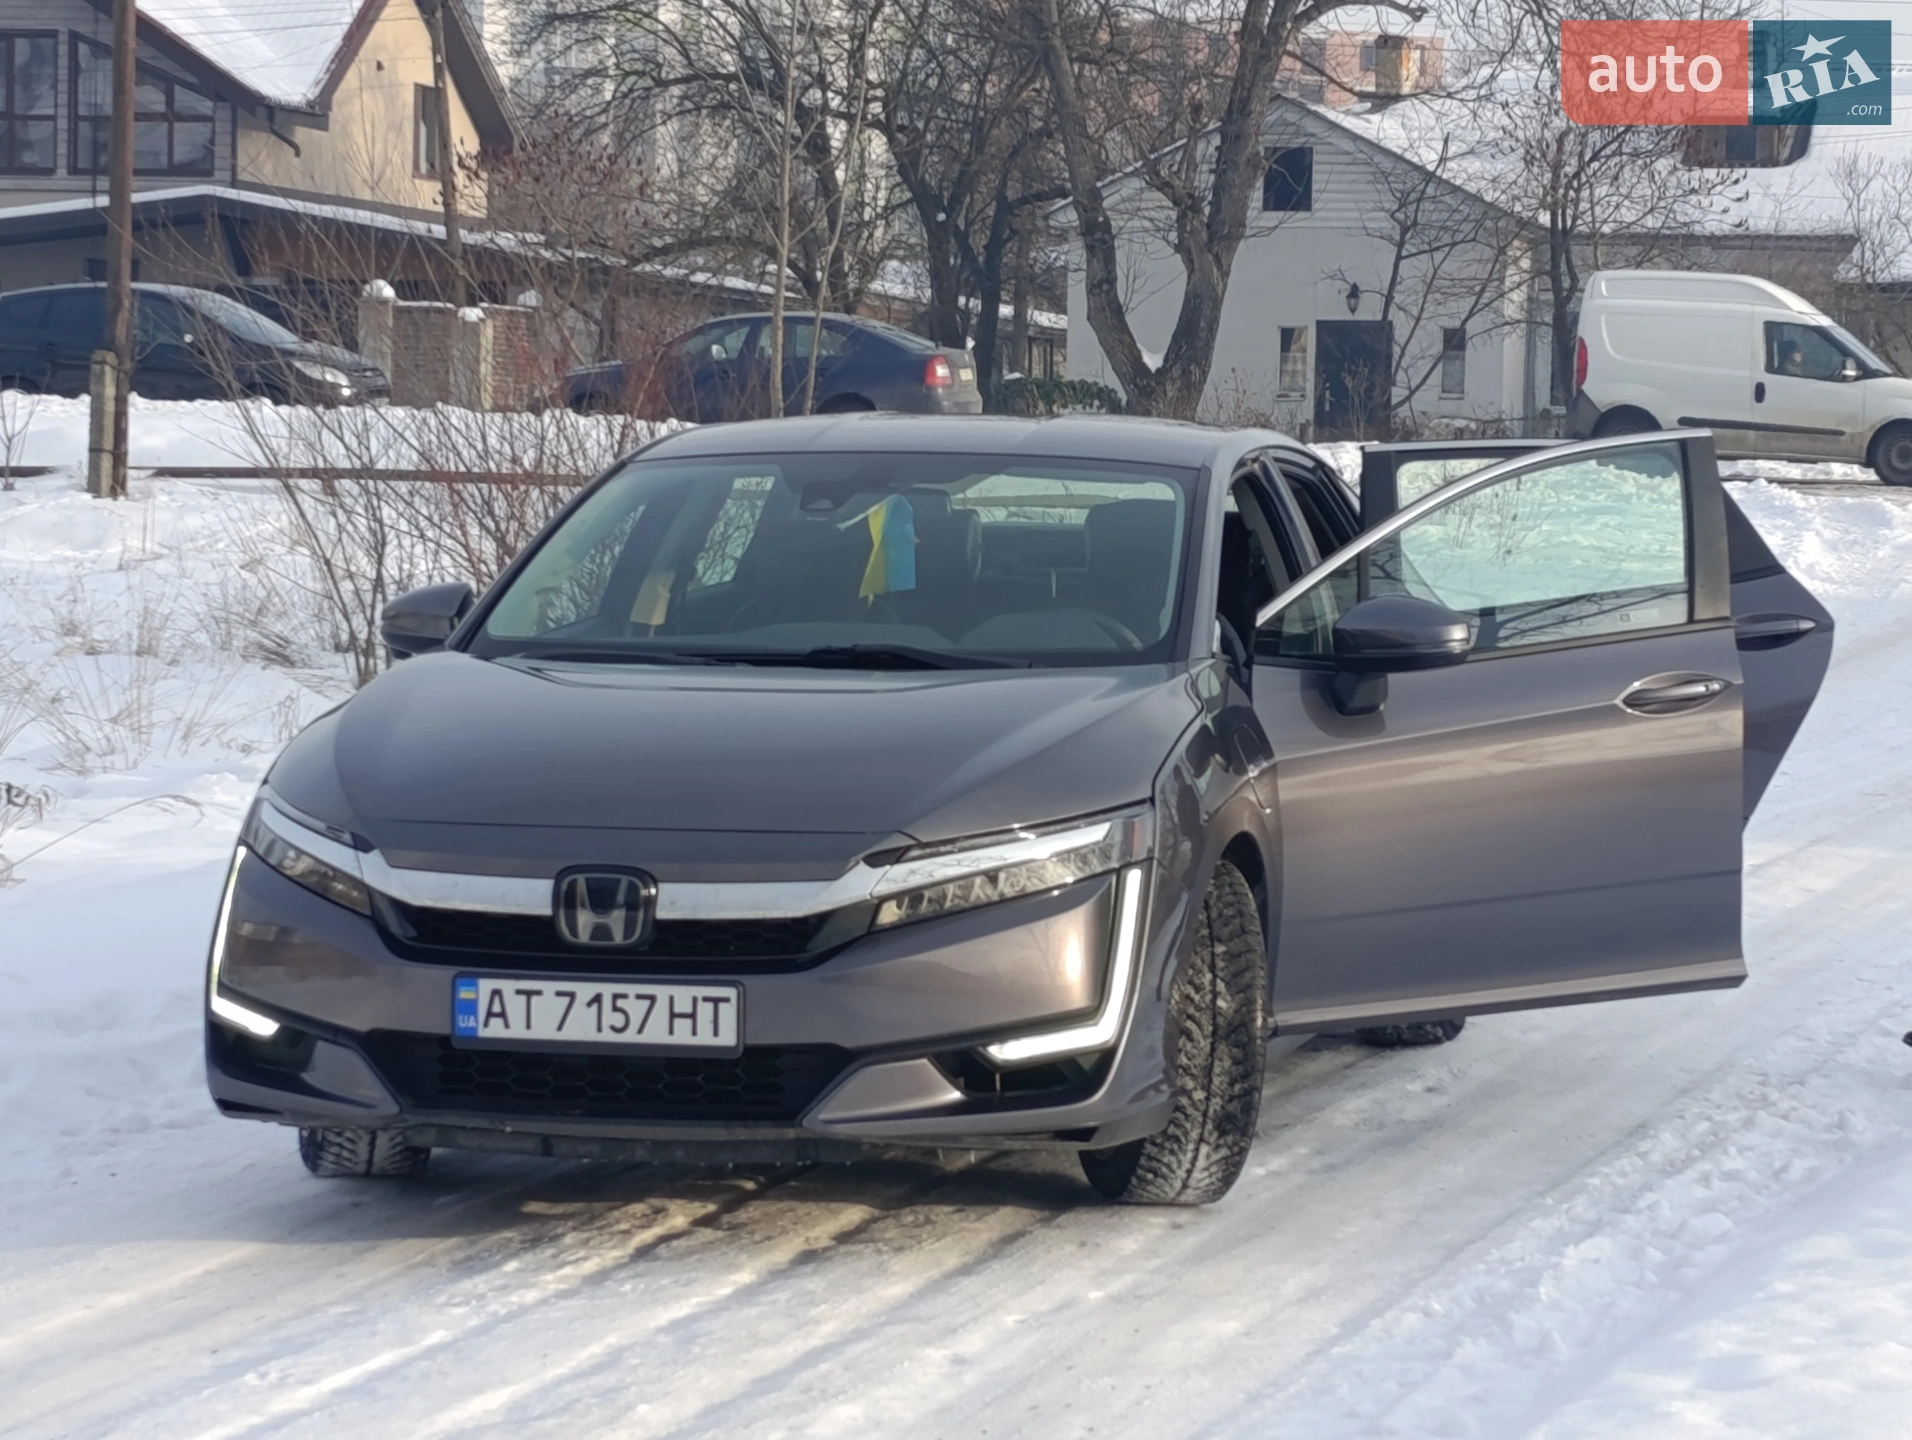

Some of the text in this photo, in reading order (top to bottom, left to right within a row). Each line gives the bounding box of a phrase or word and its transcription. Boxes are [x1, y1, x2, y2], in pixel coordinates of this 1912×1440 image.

[459, 1014, 477, 1028] UA
[483, 988, 731, 1037] AT 7157 HT
